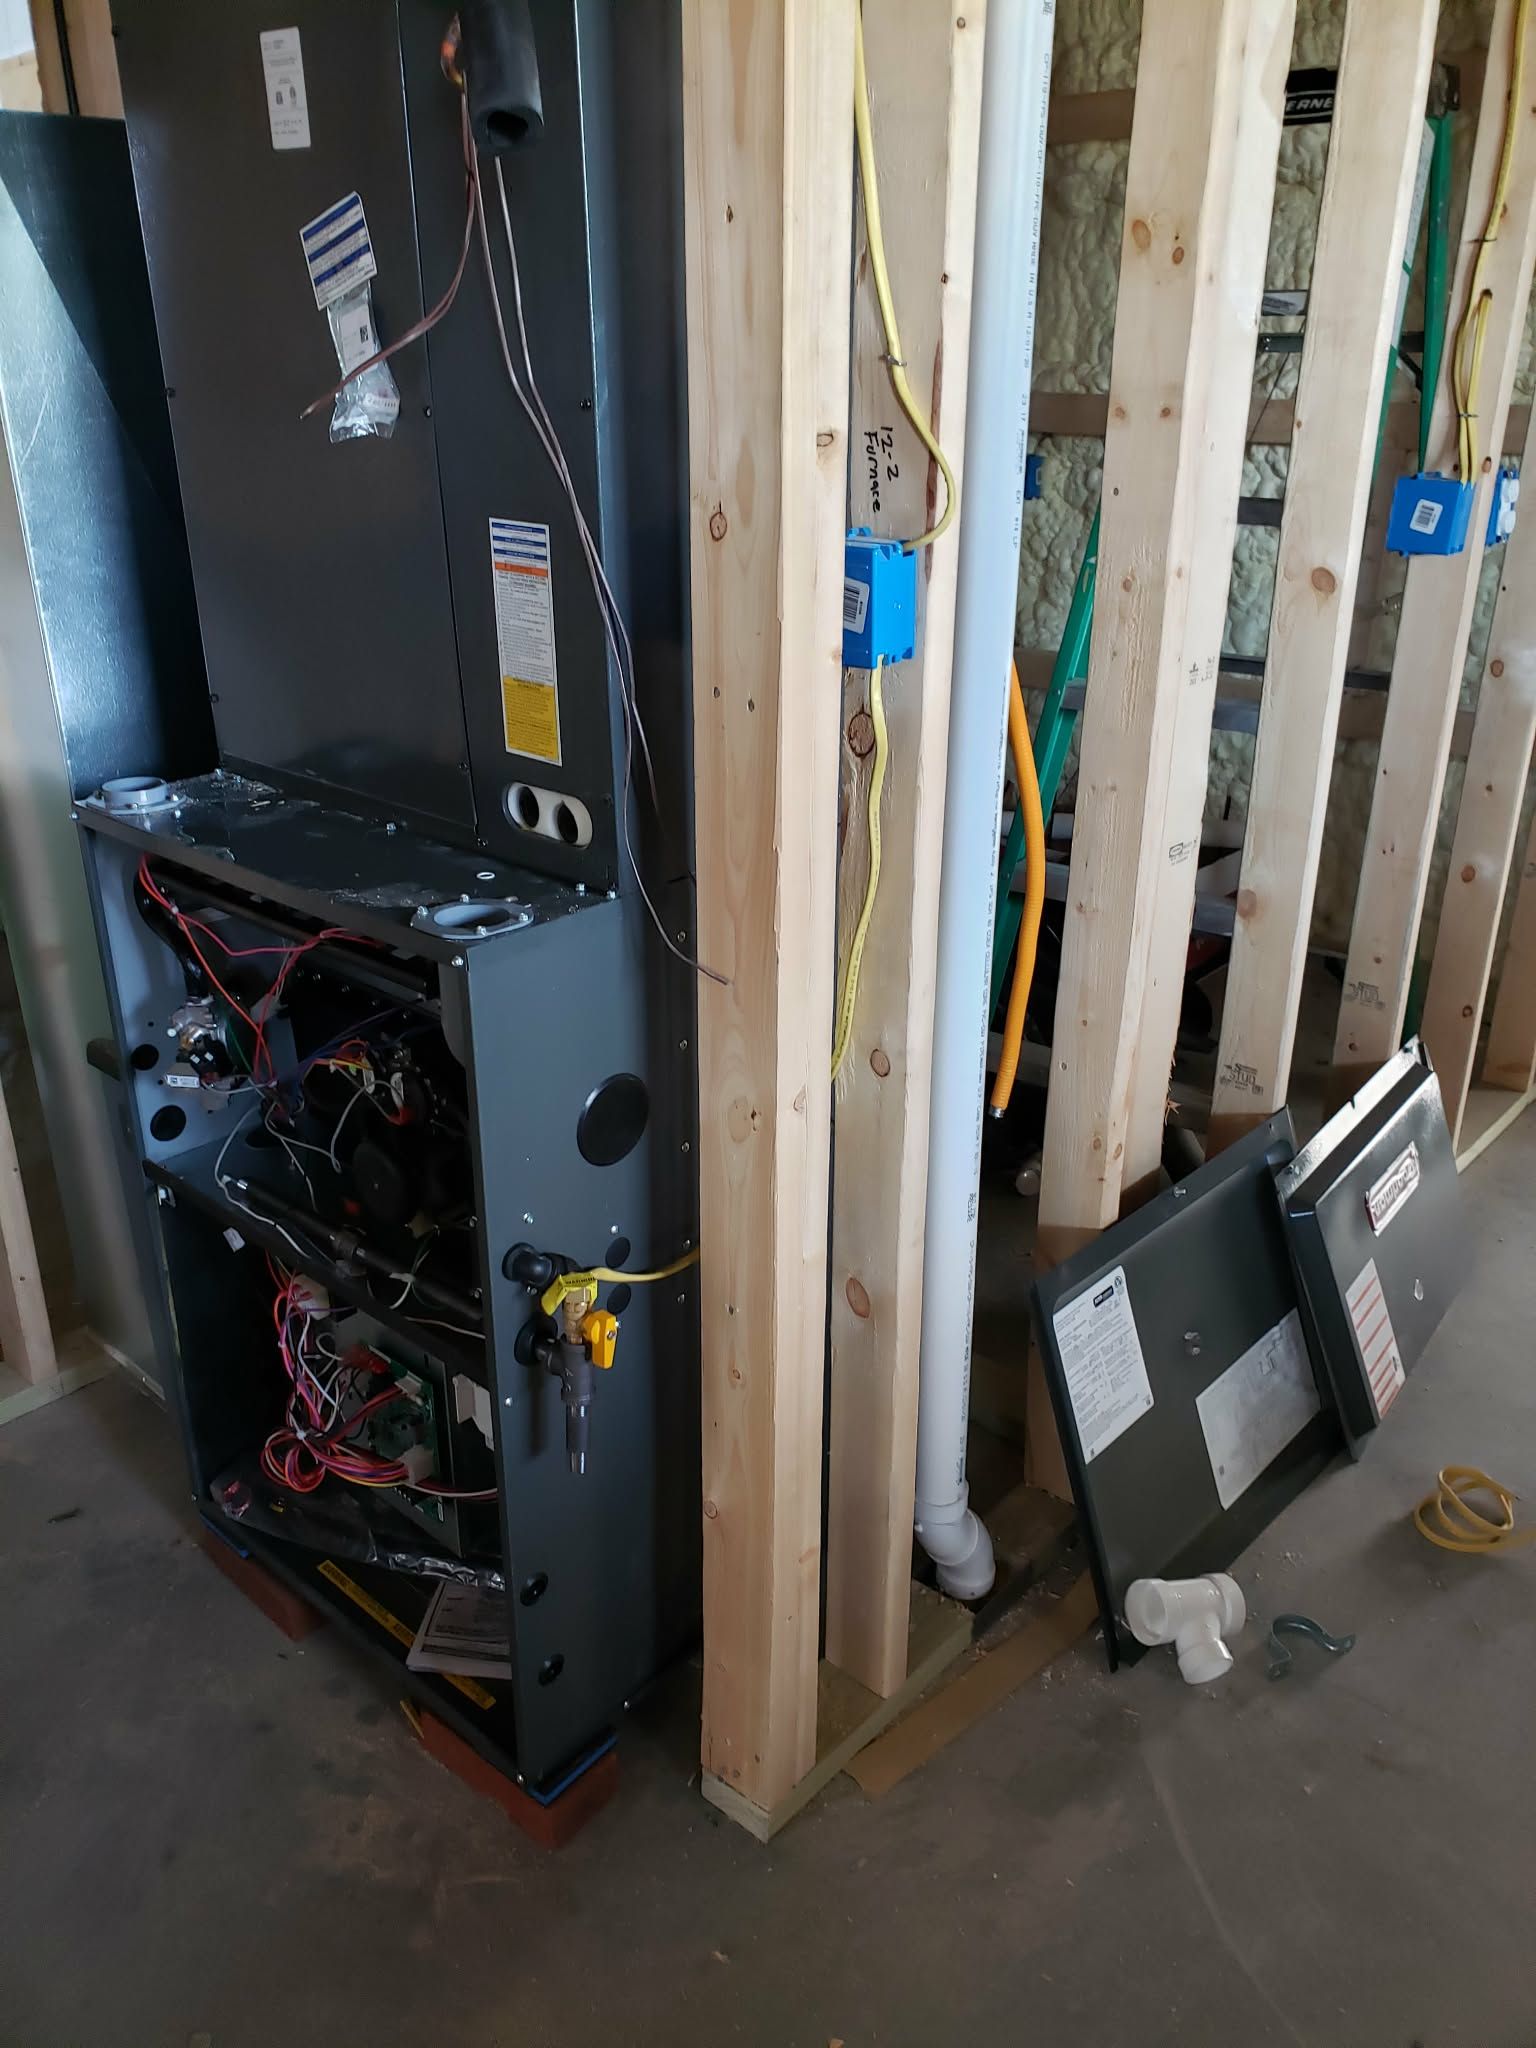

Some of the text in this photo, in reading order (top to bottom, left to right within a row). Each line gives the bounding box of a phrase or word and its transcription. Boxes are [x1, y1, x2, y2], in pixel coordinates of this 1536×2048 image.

[1285, 97, 1334, 111] ERNE
[864, 431, 881, 513] Furnace
[880, 426, 899, 482] 12-2
